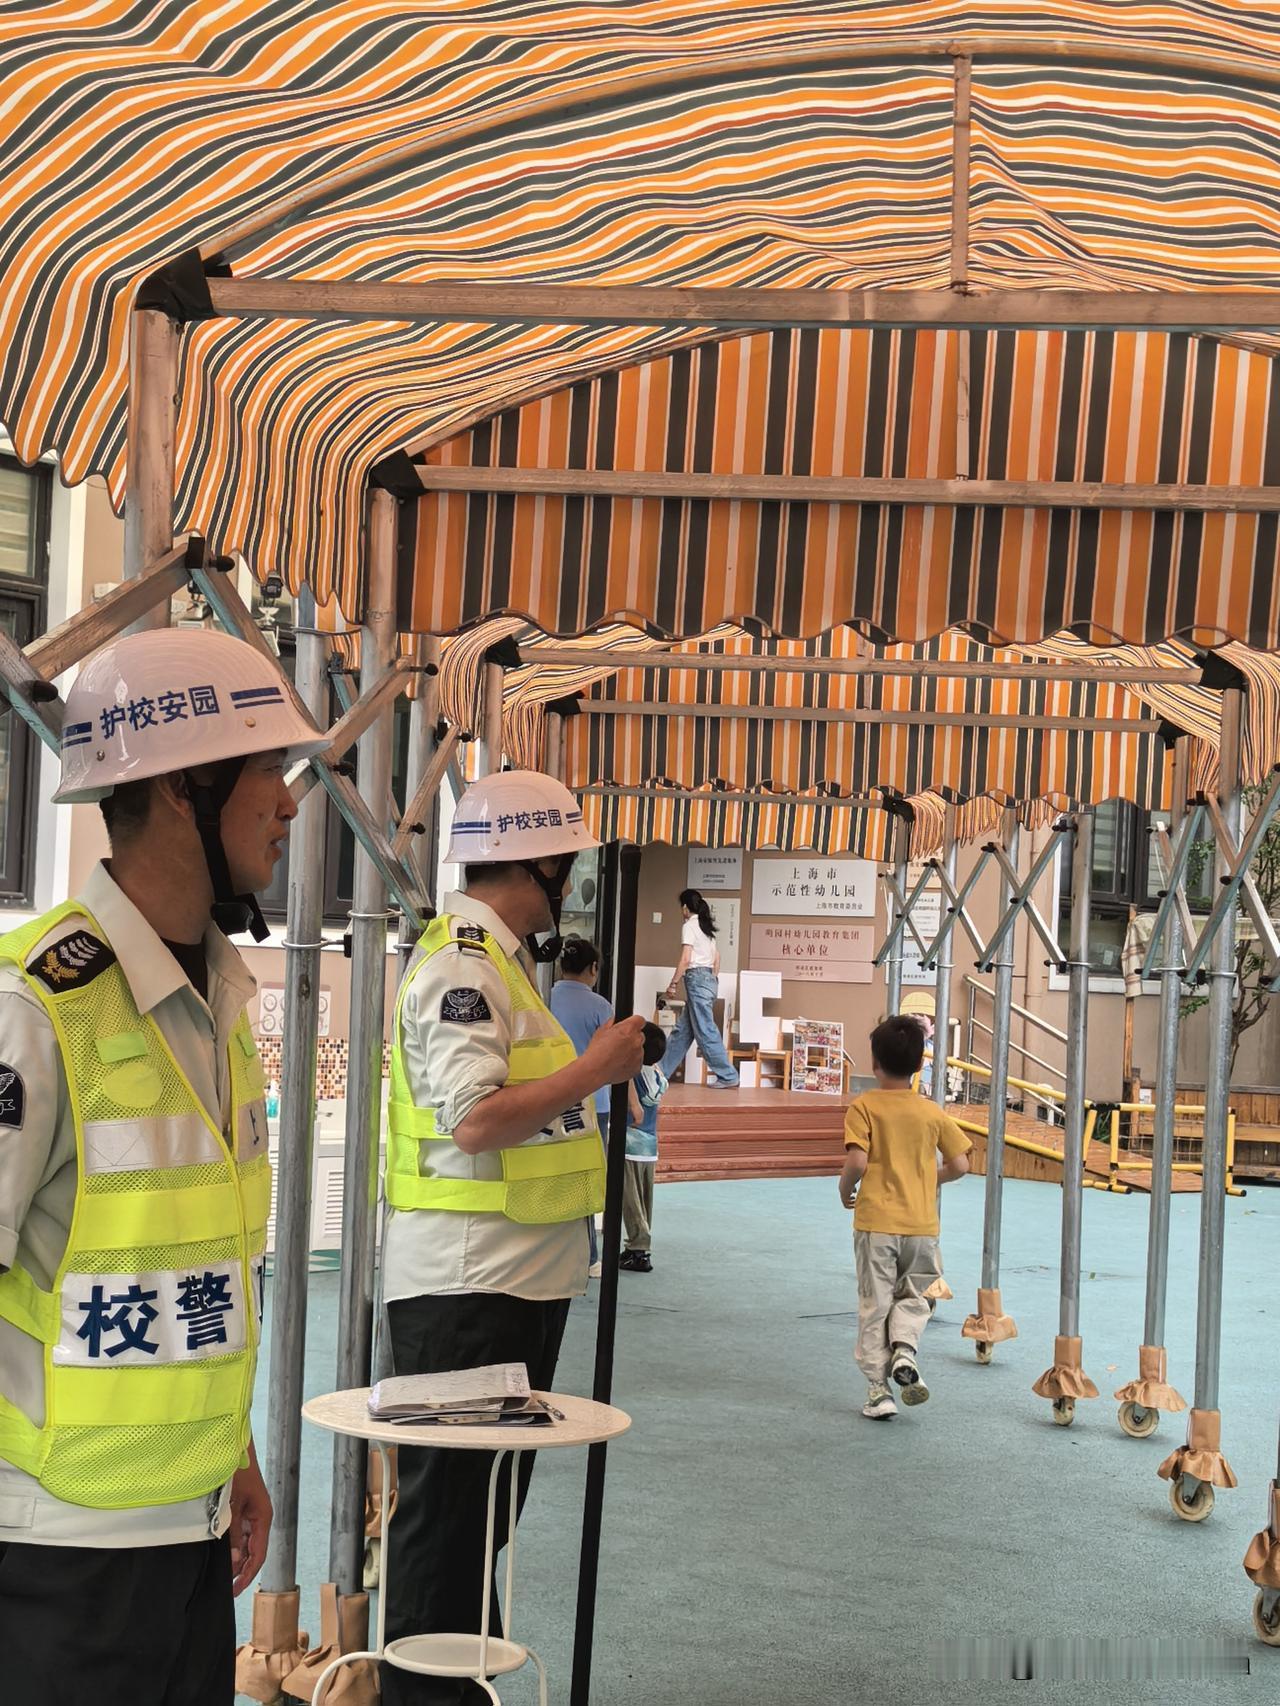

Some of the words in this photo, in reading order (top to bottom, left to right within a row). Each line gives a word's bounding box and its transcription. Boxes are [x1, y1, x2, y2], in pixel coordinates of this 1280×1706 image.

[100, 684, 221, 740] 护校安园
[496, 809, 563, 834] 护校安园
[791, 866, 837, 880] 上海市
[771, 883, 856, 897] 示范性幼儿园
[782, 943, 829, 956] 核心单位
[75, 1270, 234, 1359] 校警
